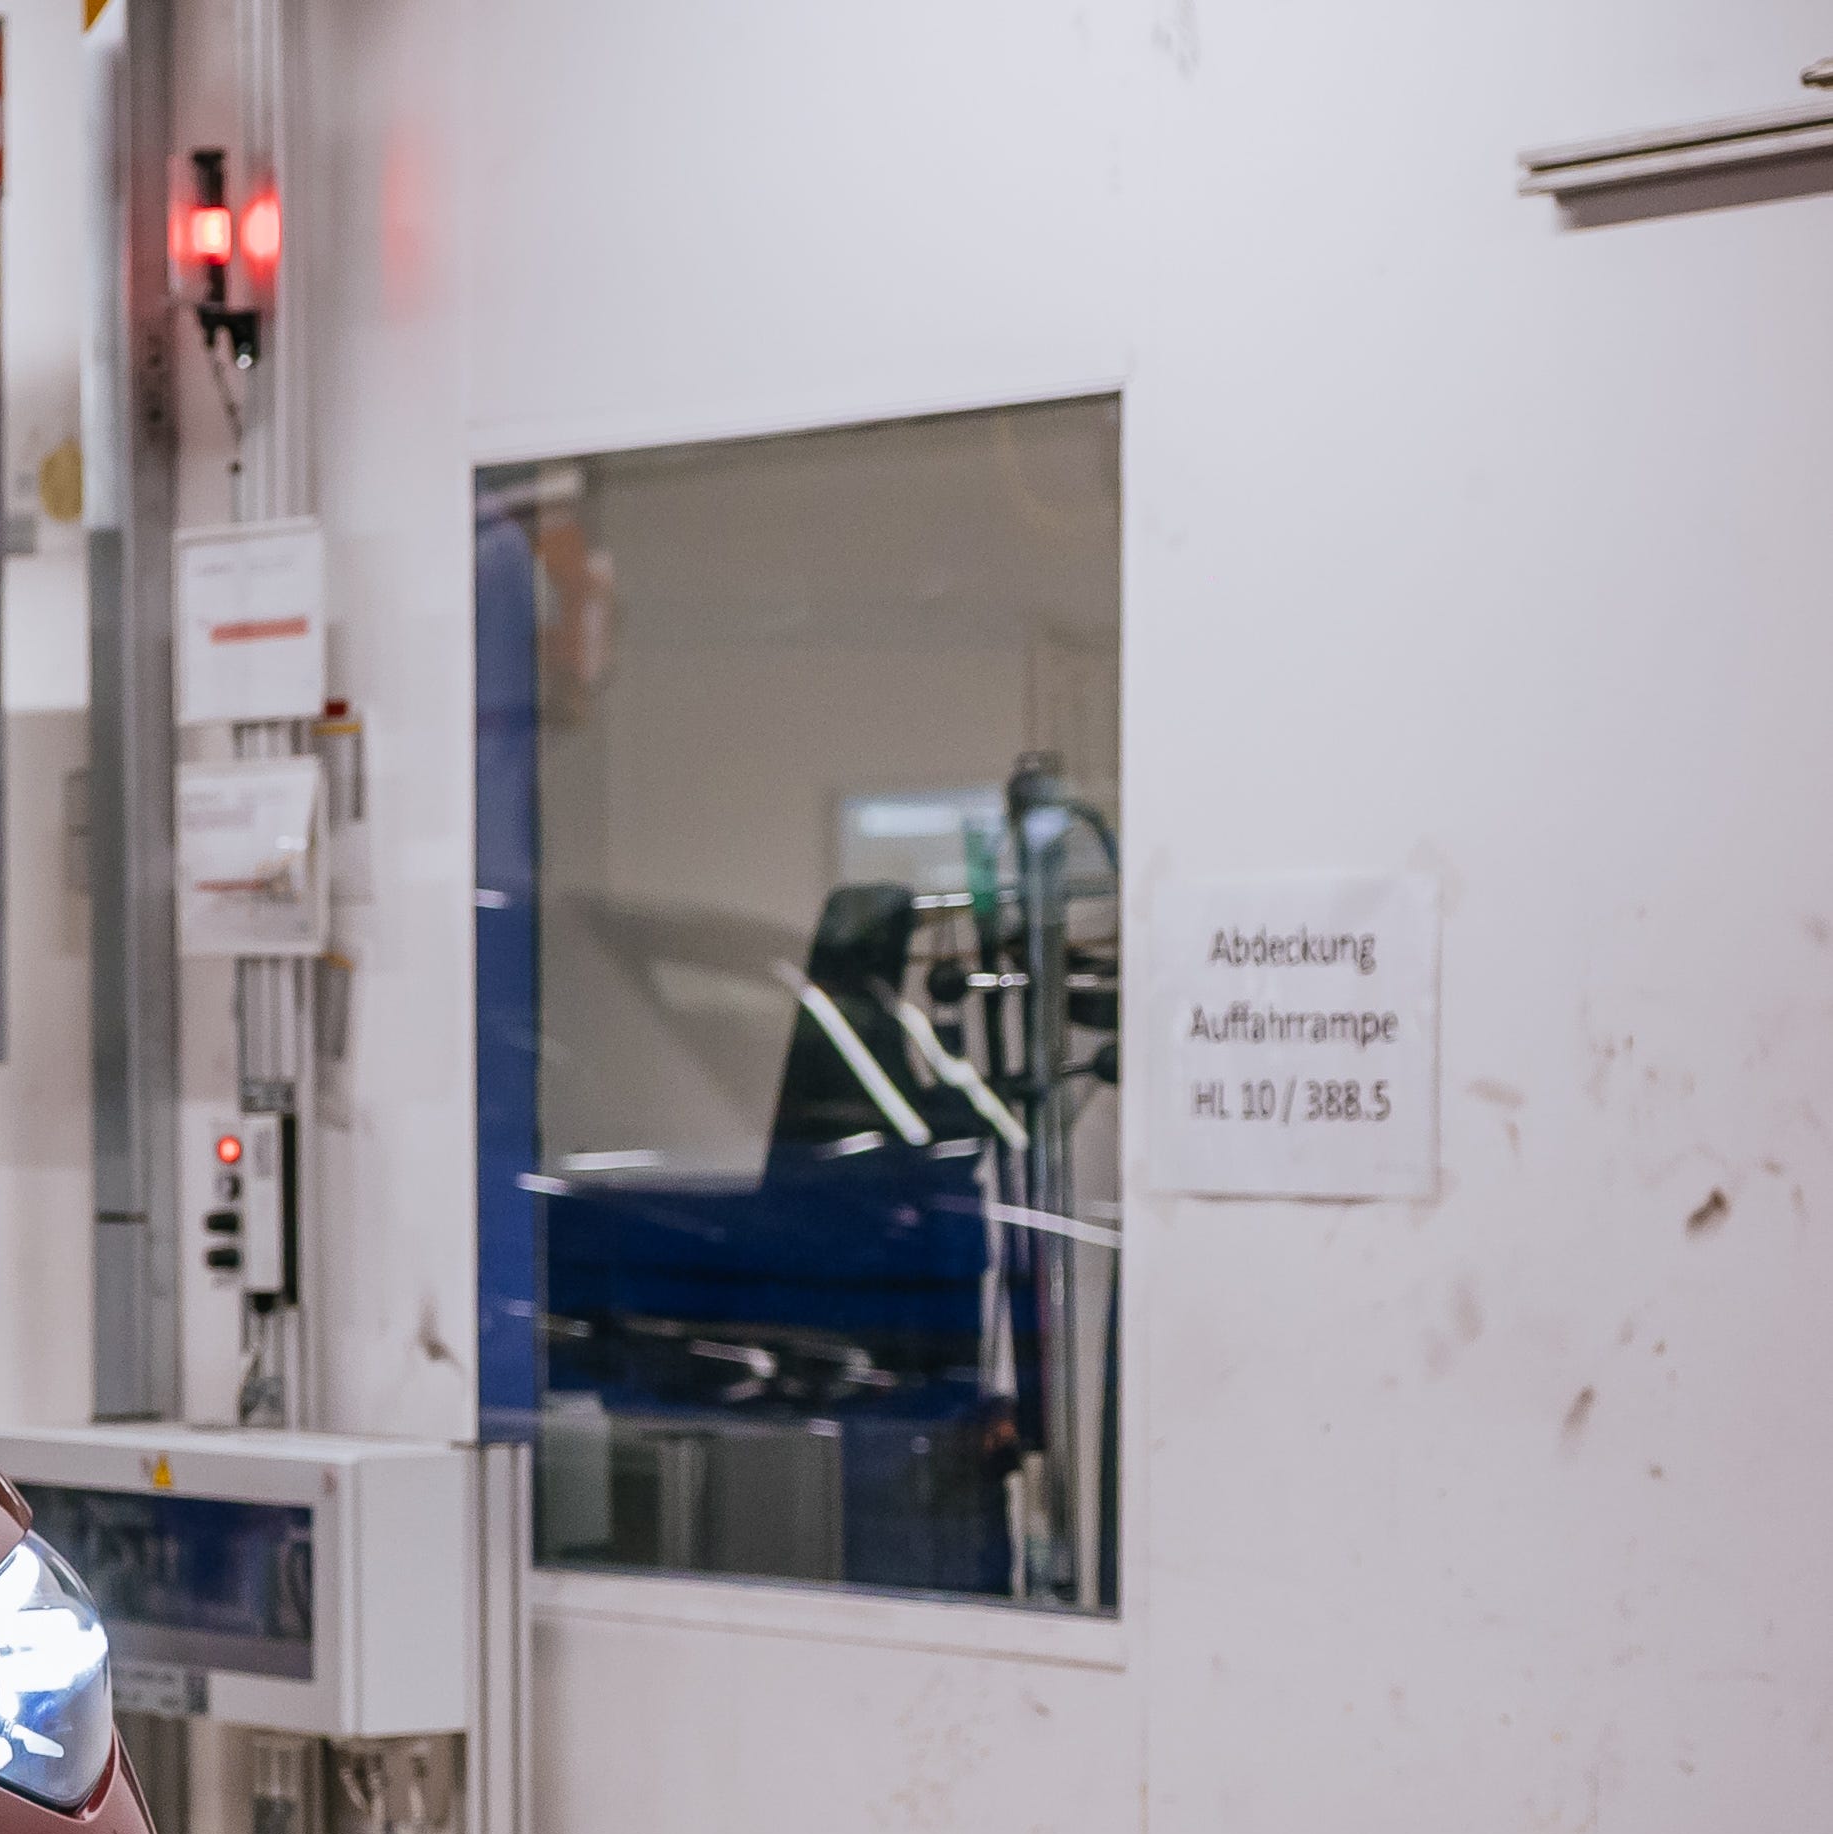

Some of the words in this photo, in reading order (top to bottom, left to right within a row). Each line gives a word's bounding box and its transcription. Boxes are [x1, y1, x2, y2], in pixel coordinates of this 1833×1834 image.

[1207, 924, 1377, 975] Abdeckung
[1190, 1001, 1399, 1050] Auffahrrampe
[1193, 1080, 1230, 1120] HL
[1241, 1079, 1276, 1120] 10
[1282, 1075, 1298, 1125] /
